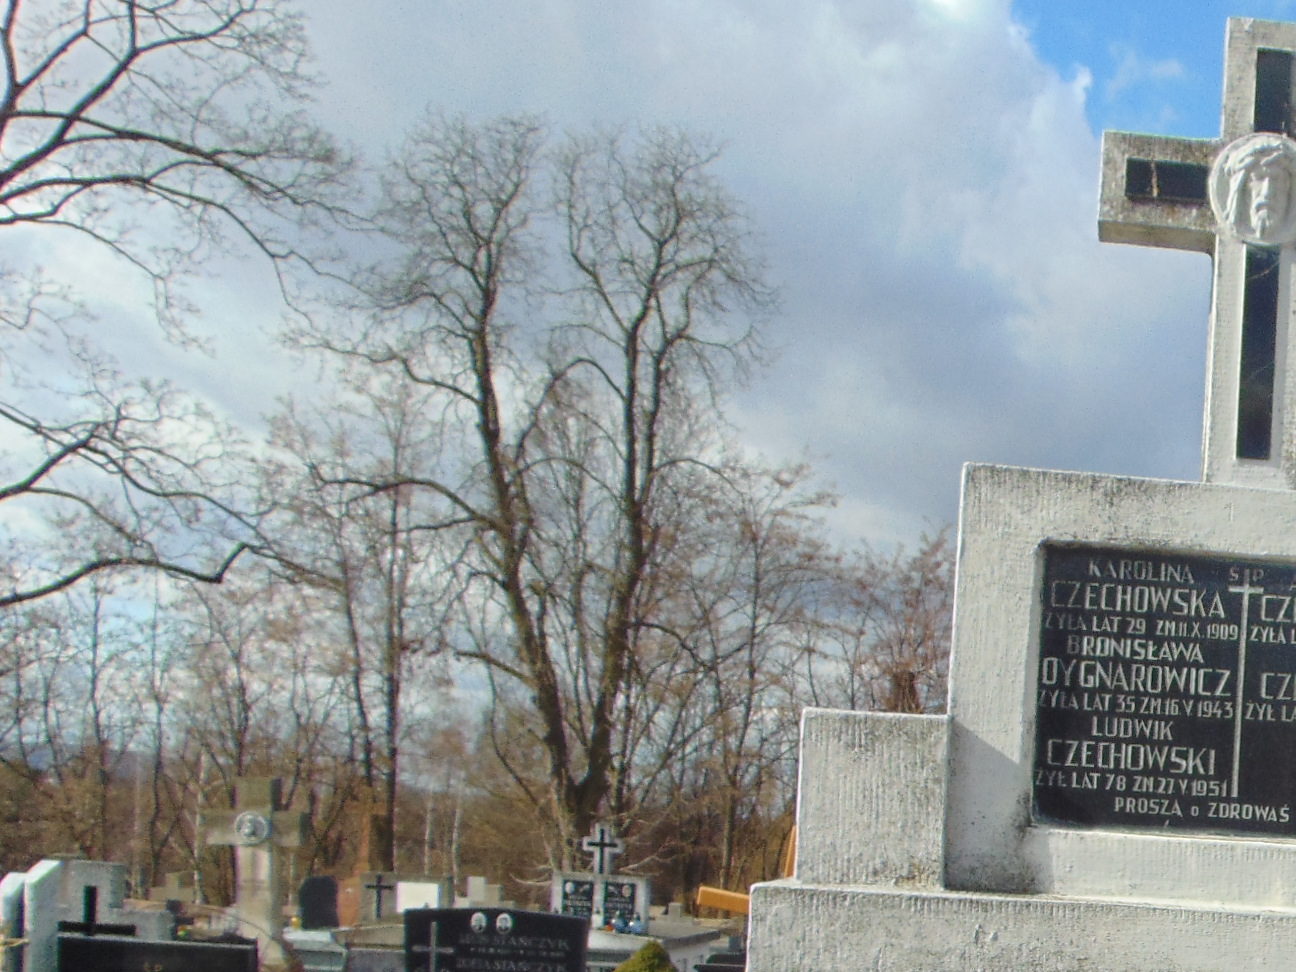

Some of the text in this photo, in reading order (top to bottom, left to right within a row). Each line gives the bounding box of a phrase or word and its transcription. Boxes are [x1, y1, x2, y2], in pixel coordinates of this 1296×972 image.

[1089, 559, 1194, 584] KAROLINA
[1052, 581, 1225, 618] CZECHOWSKA
[1092, 616, 1121, 632] LAT
[1127, 618, 1146, 635] 29
[1067, 635, 1204, 663] BRONISŁAWA
[1084, 693, 1113, 711] LAT
[1116, 695, 1135, 713] 35
[1092, 716, 1174, 740] LUDWIK
[1047, 739, 1215, 775] CZECHOWSKI
[1072, 771, 1100, 789] LAT
[1105, 774, 1126, 791] 78
[1207, 802, 1290, 822] ZDROWAŚ
